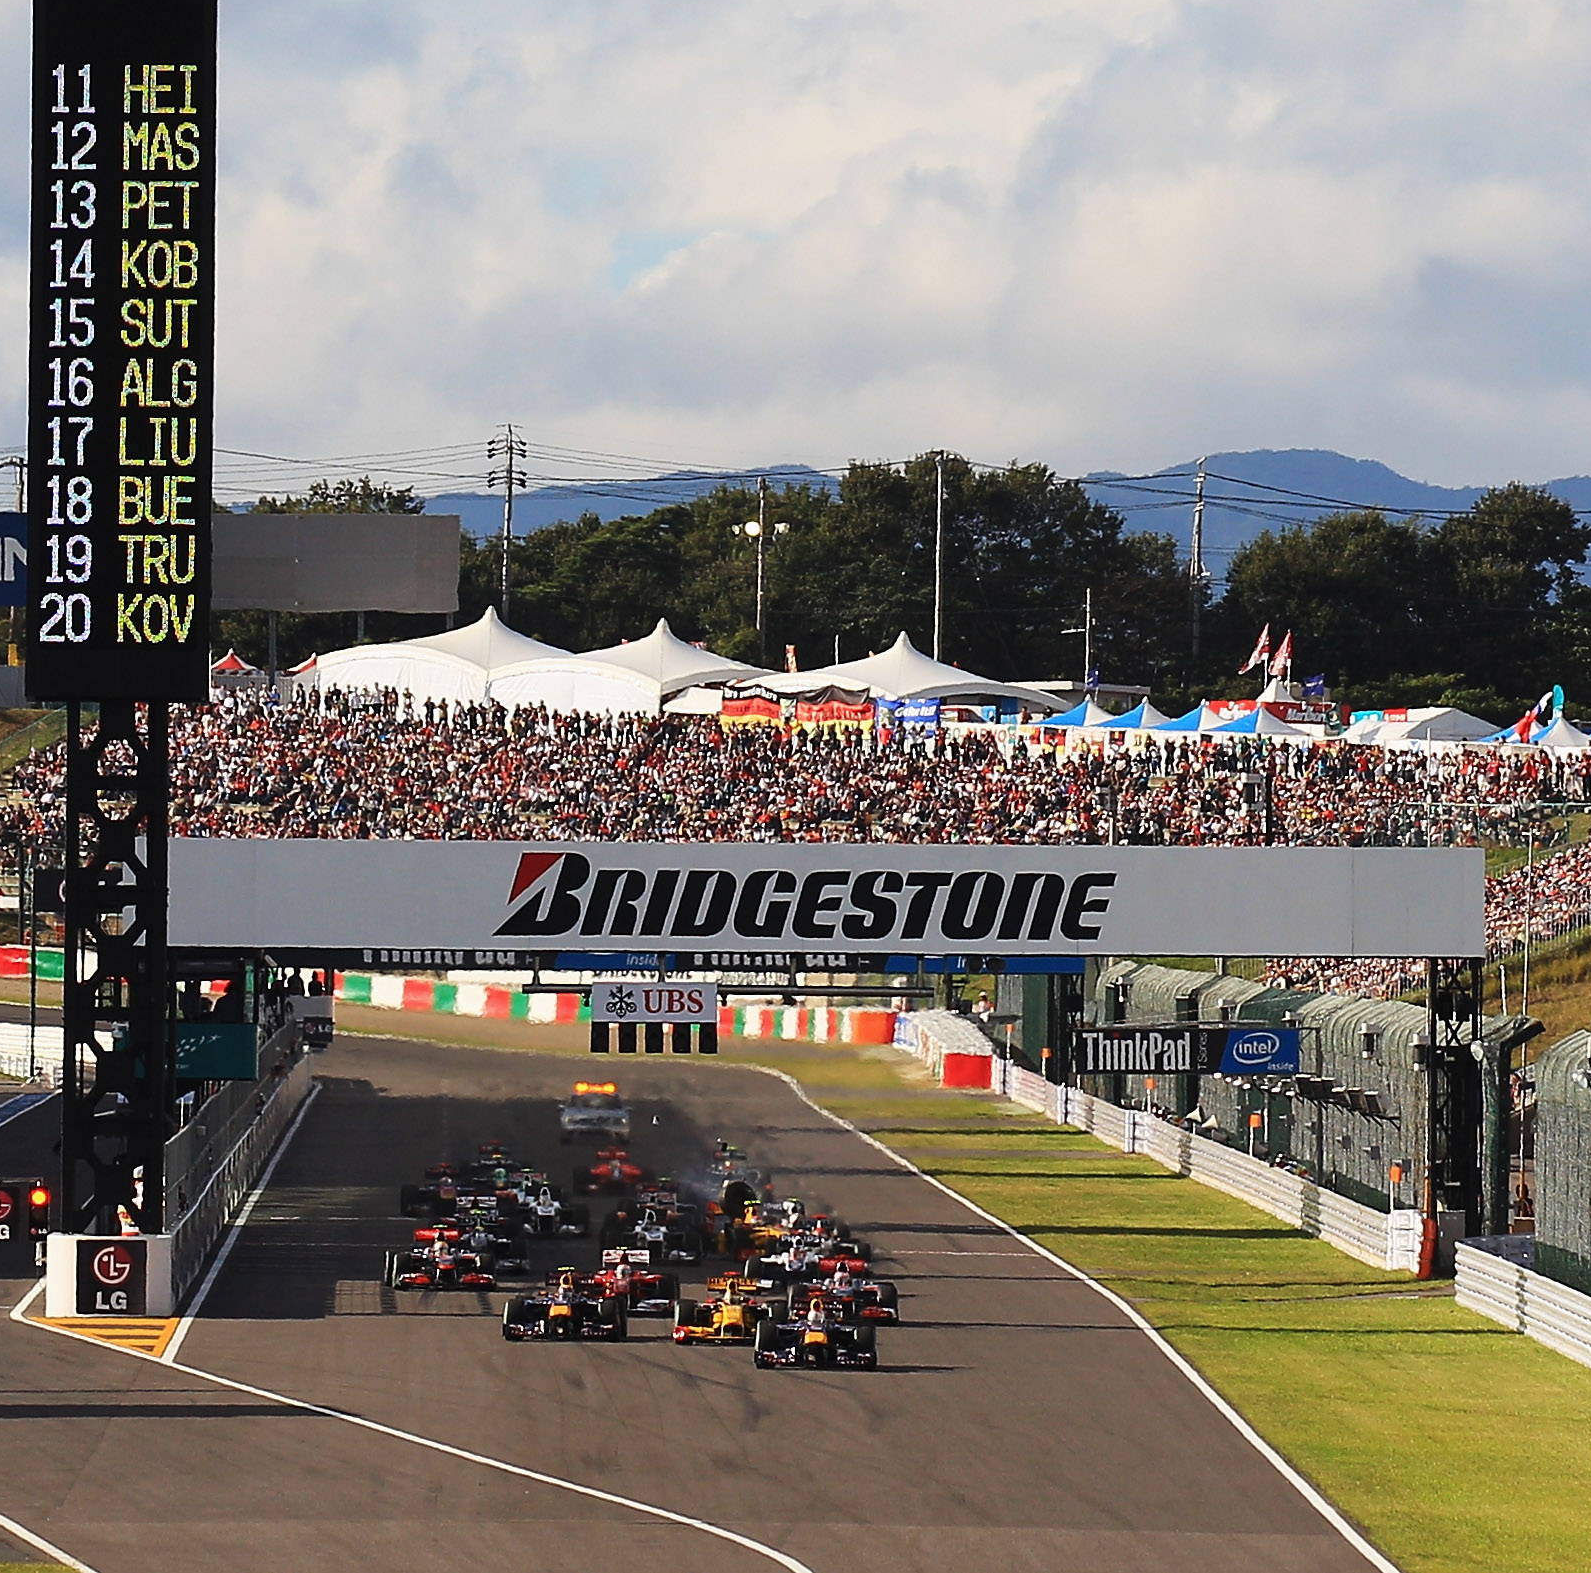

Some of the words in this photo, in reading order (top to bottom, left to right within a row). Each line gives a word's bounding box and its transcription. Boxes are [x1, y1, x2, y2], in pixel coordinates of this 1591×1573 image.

[52, 64, 95, 113] 11
[124, 65, 197, 113] HEI
[51, 121, 96, 170] 12
[123, 121, 199, 170] MAS
[50, 180, 96, 229] 13
[122, 181, 199, 229] PET
[50, 239, 95, 288] 14
[122, 239, 198, 289] KOB
[49, 298, 94, 347] 15
[121, 299, 197, 348] SUT
[48, 358, 94, 406] 16
[120, 358, 197, 407] ALG
[48, 417, 93, 465] 17
[119, 417, 196, 466] LIU
[47, 475, 92, 524] 18
[119, 476, 195, 525] BUE
[46, 535, 92, 583] 19
[118, 535, 195, 584] TRU
[40, 593, 91, 642] 20
[117, 593, 194, 643] KOV
[493, 852, 1116, 940] BRIDGESTONE
[626, 953, 659, 966] insid
[642, 988, 704, 1014] UBS
[1082, 1031, 1191, 1071] ThinkPad
[1238, 1038, 1272, 1055] intel
[95, 1291, 127, 1310] LG
